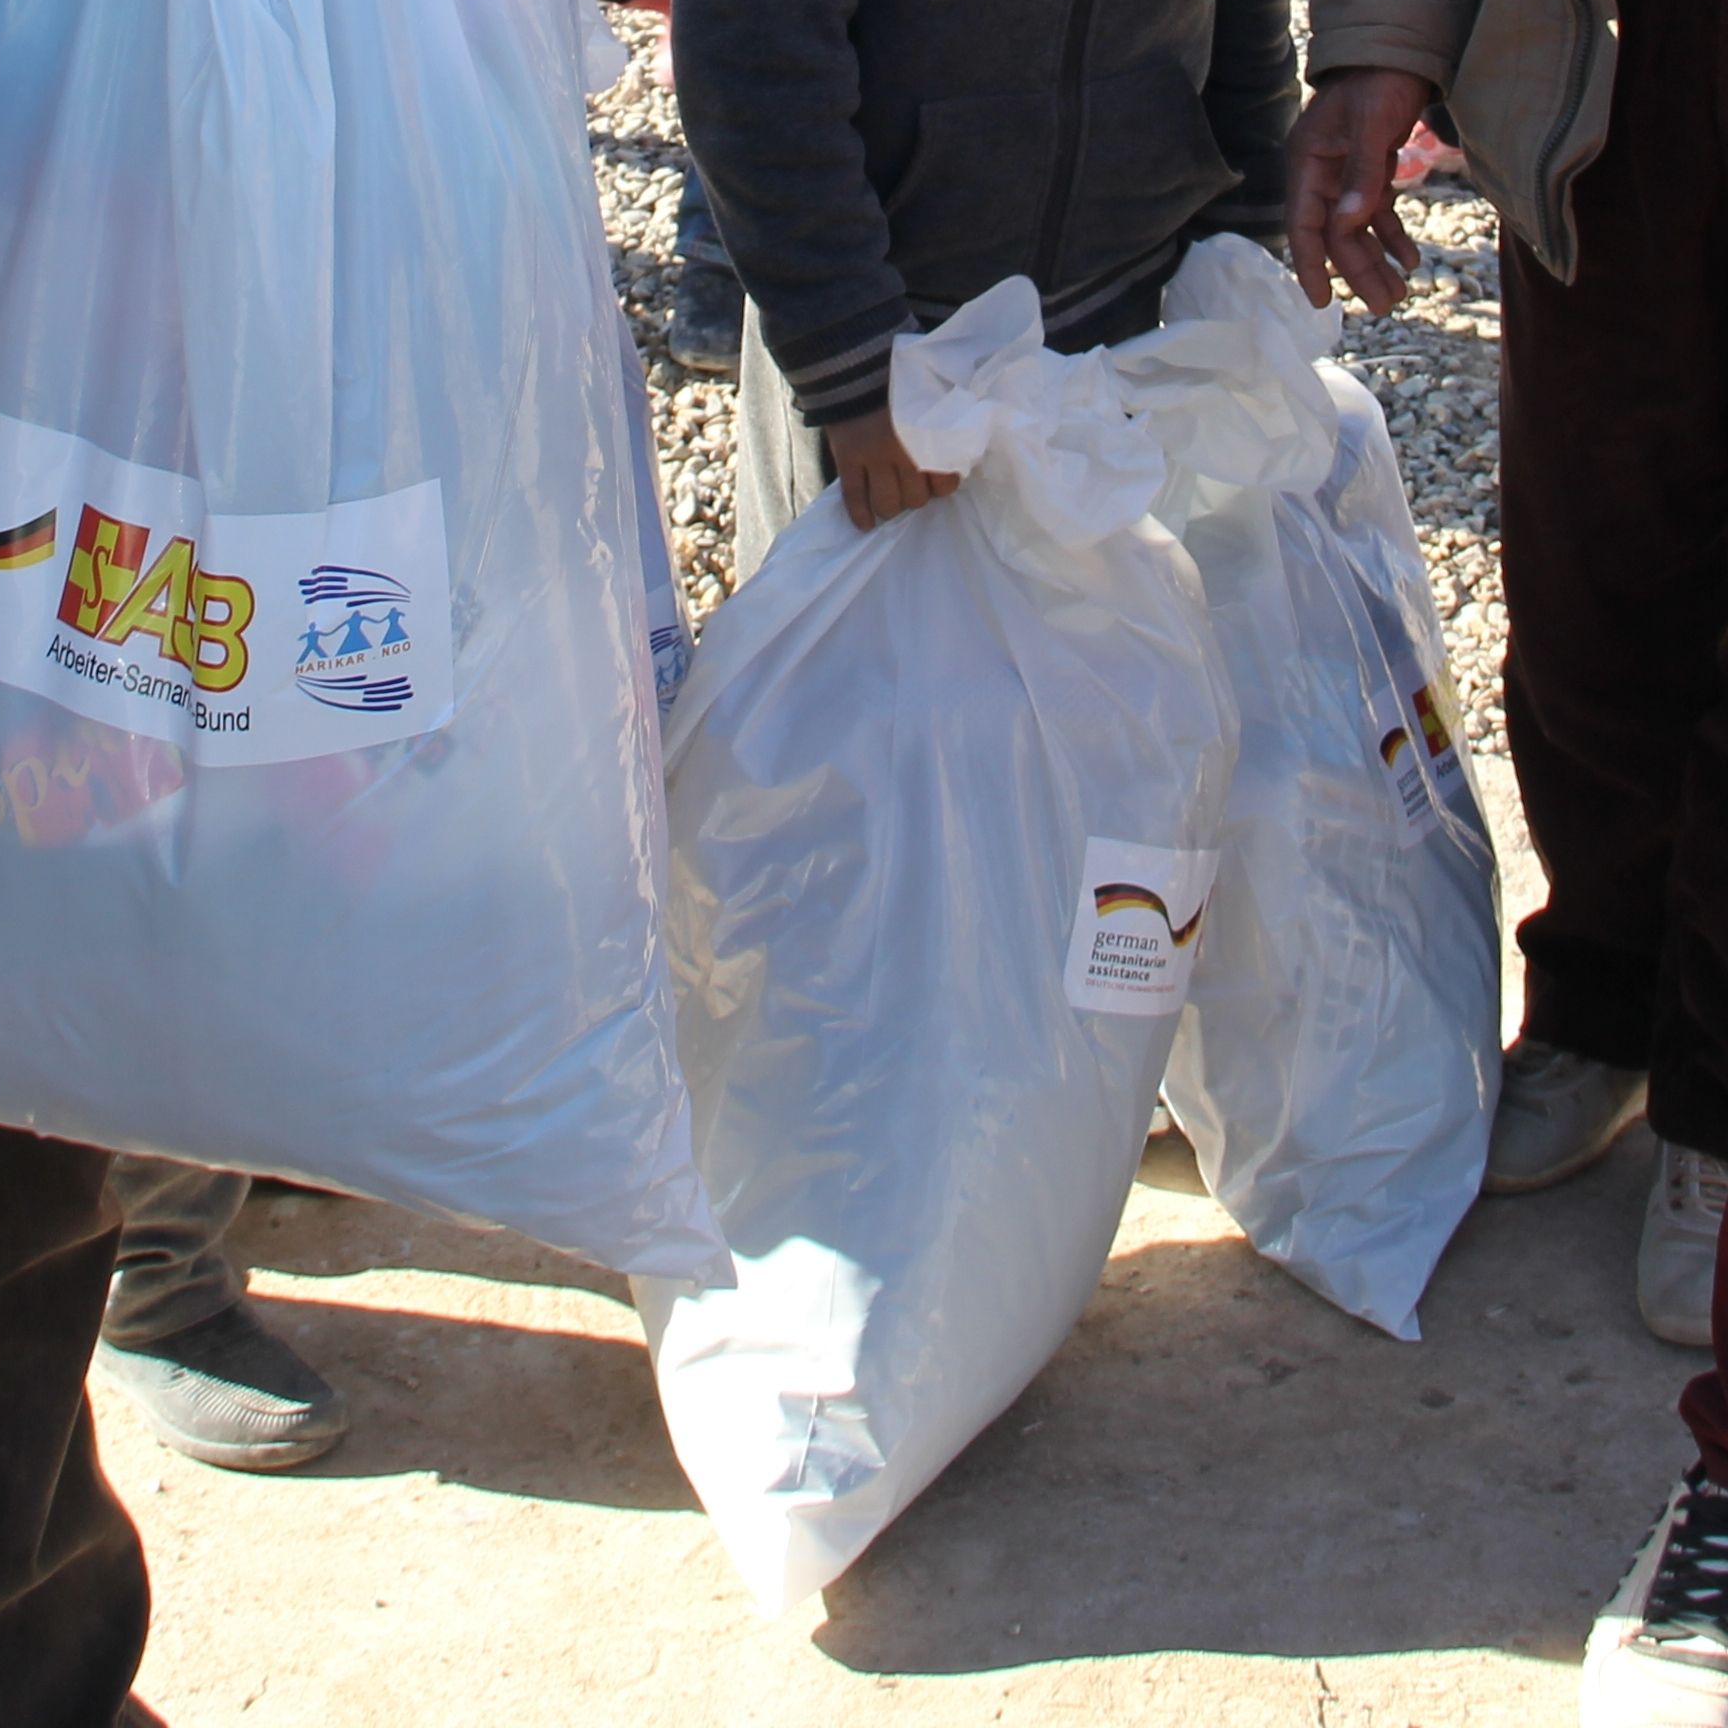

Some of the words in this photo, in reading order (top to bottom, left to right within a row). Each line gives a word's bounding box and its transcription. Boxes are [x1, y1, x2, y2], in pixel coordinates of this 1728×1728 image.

[295, 653, 365, 674] HARIKAR
[382, 641, 411, 658] NGO
[1094, 931, 1159, 952] german
[1088, 964, 1151, 983] assistance
